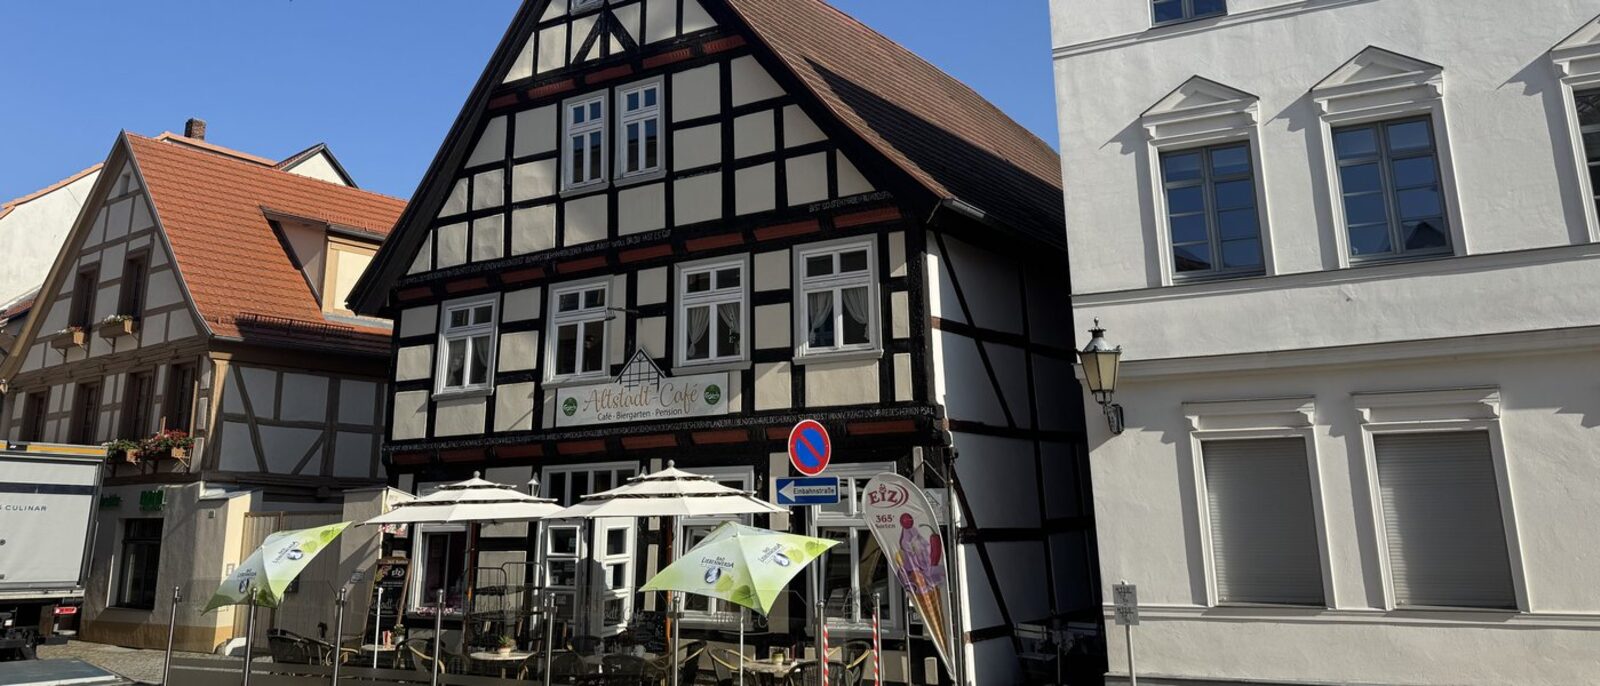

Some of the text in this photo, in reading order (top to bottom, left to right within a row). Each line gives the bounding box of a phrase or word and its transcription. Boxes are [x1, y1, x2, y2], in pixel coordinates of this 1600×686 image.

[597, 407, 683, 421] Café Biergarten Pension
[793, 487, 834, 495] Einbahnstraße
[5, 504, 47, 512] CULINAR
